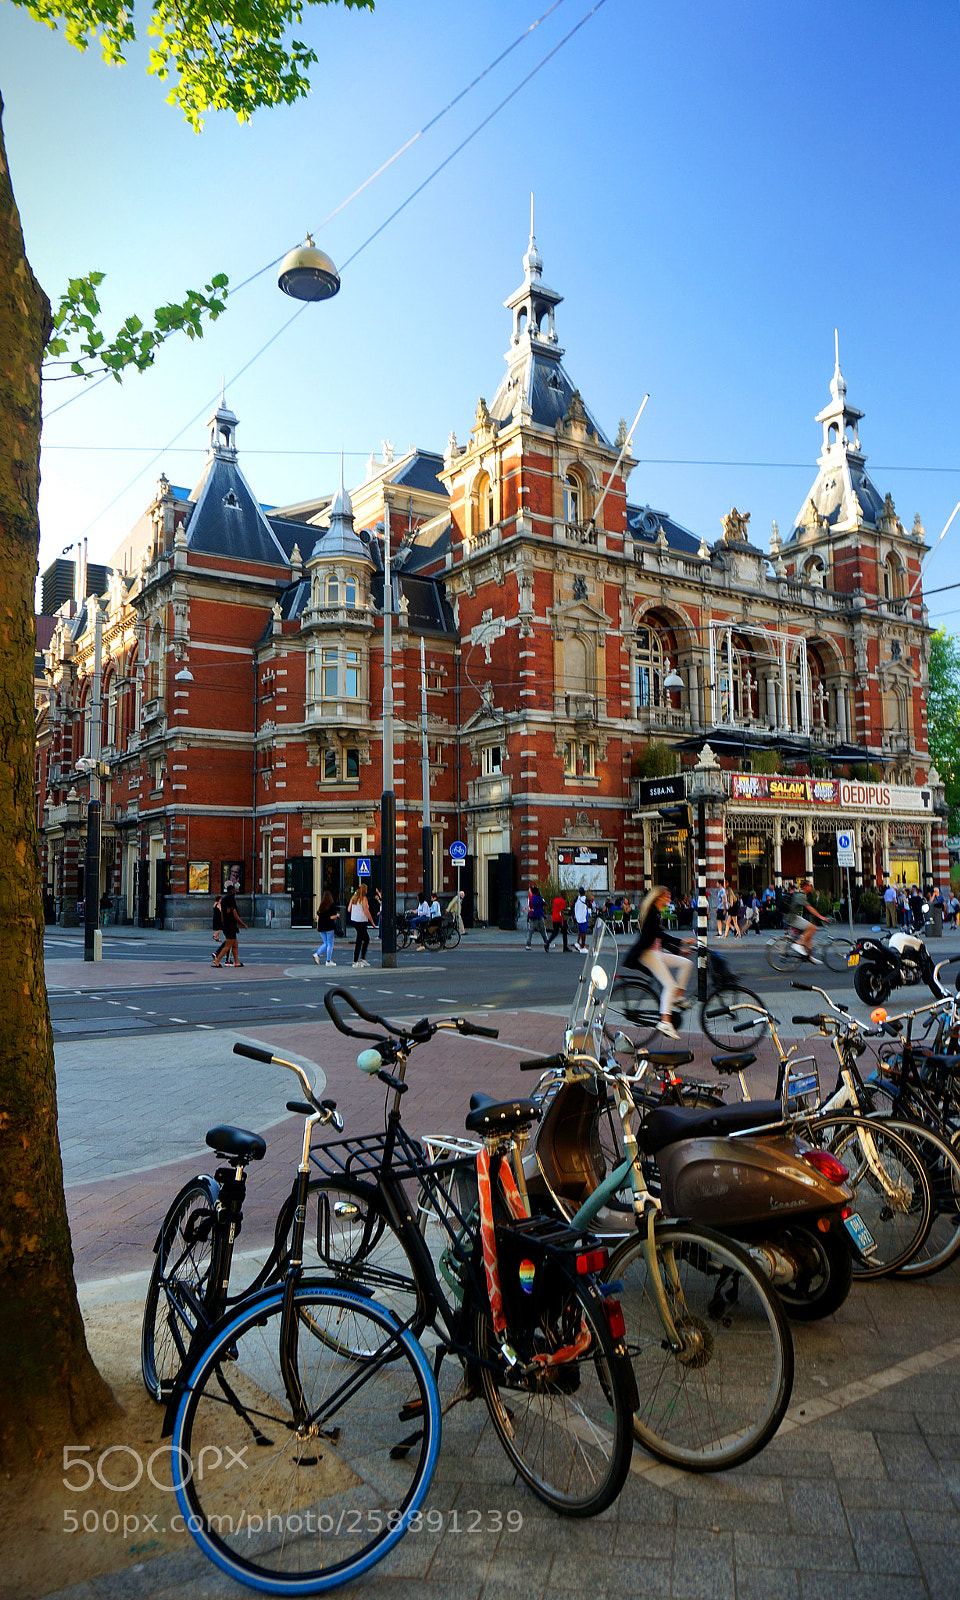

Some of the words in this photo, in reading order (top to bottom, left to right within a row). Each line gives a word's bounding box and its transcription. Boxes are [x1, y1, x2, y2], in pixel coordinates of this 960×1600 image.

[649, 785, 675, 796] SSBA.NL
[770, 781, 805, 794] SALAM
[842, 785, 890, 806] OEDIPUS
